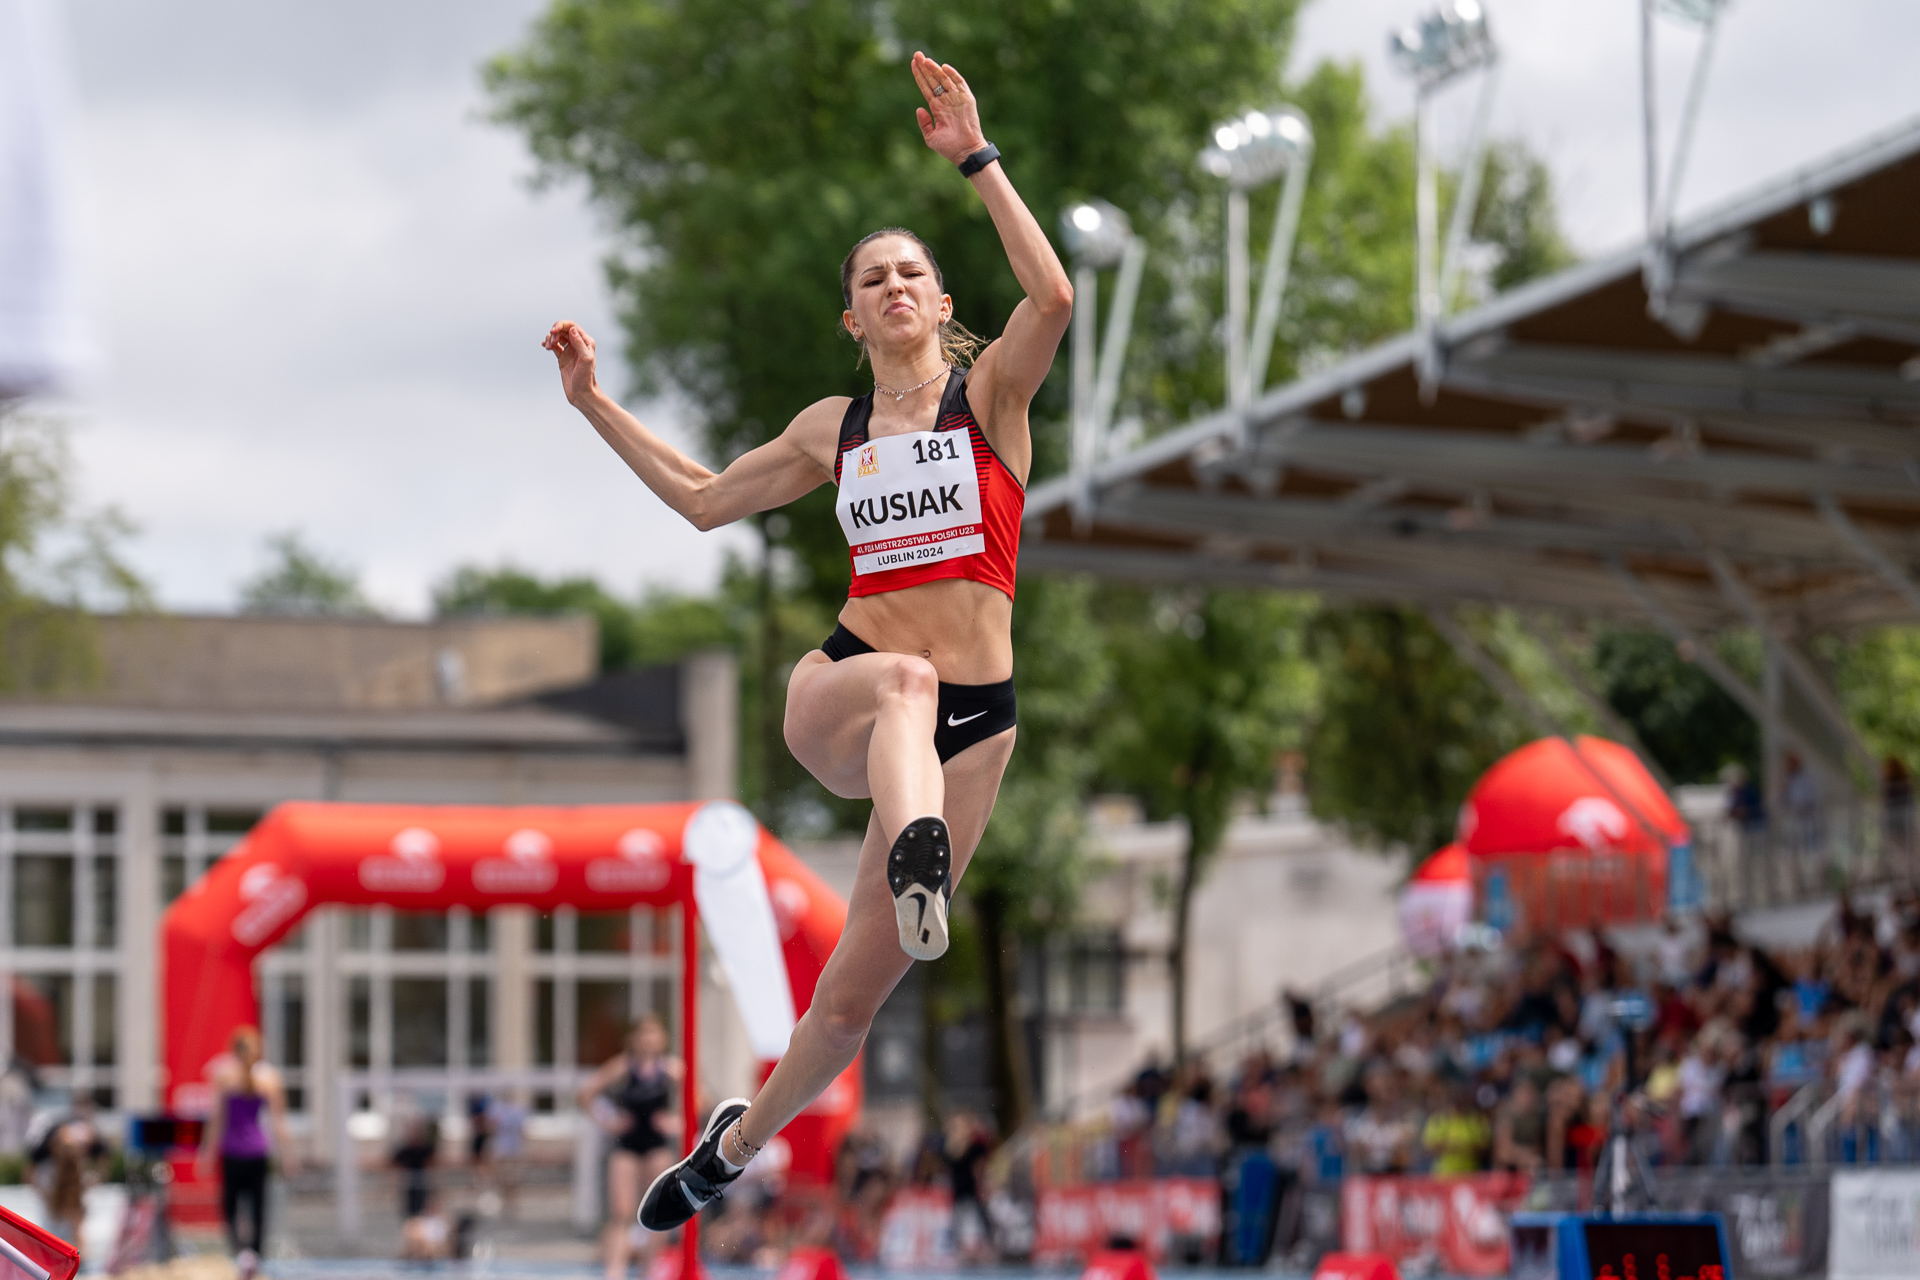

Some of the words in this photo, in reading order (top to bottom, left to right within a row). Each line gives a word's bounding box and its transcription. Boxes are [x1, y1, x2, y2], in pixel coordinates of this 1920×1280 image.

[912, 438, 960, 464] 181
[849, 484, 964, 529] KUSIAK
[874, 535, 931, 551] MISTRZOSTWA
[931, 529, 958, 542] POLSKI
[959, 526, 975, 535] U23
[877, 551, 915, 566] LUBLIN
[916, 546, 944, 559] 2024
